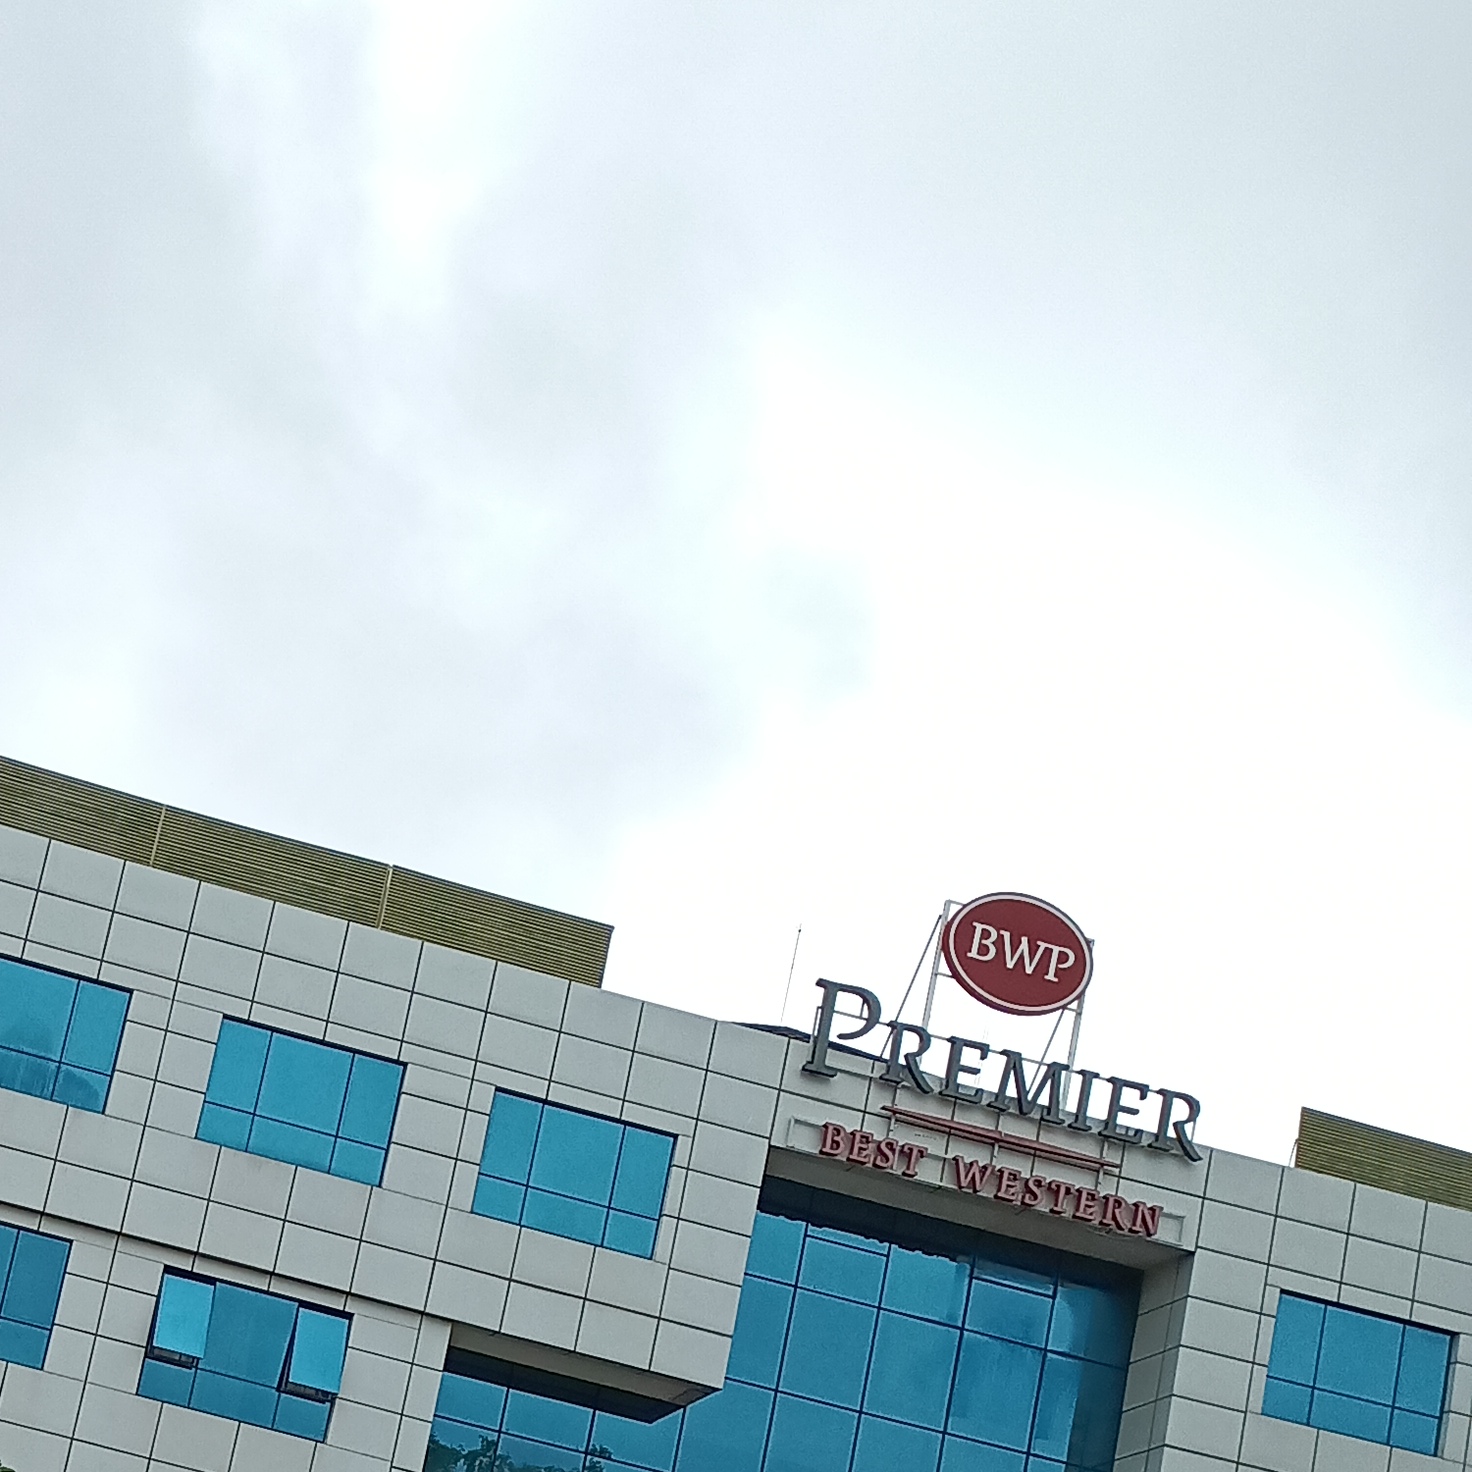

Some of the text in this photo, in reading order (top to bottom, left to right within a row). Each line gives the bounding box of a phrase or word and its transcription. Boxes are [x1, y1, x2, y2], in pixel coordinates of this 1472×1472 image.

[966, 921, 1076, 983] BWP
[802, 978, 1203, 1163] PREMIER
[819, 1121, 1164, 1237] BEST WESTERN
